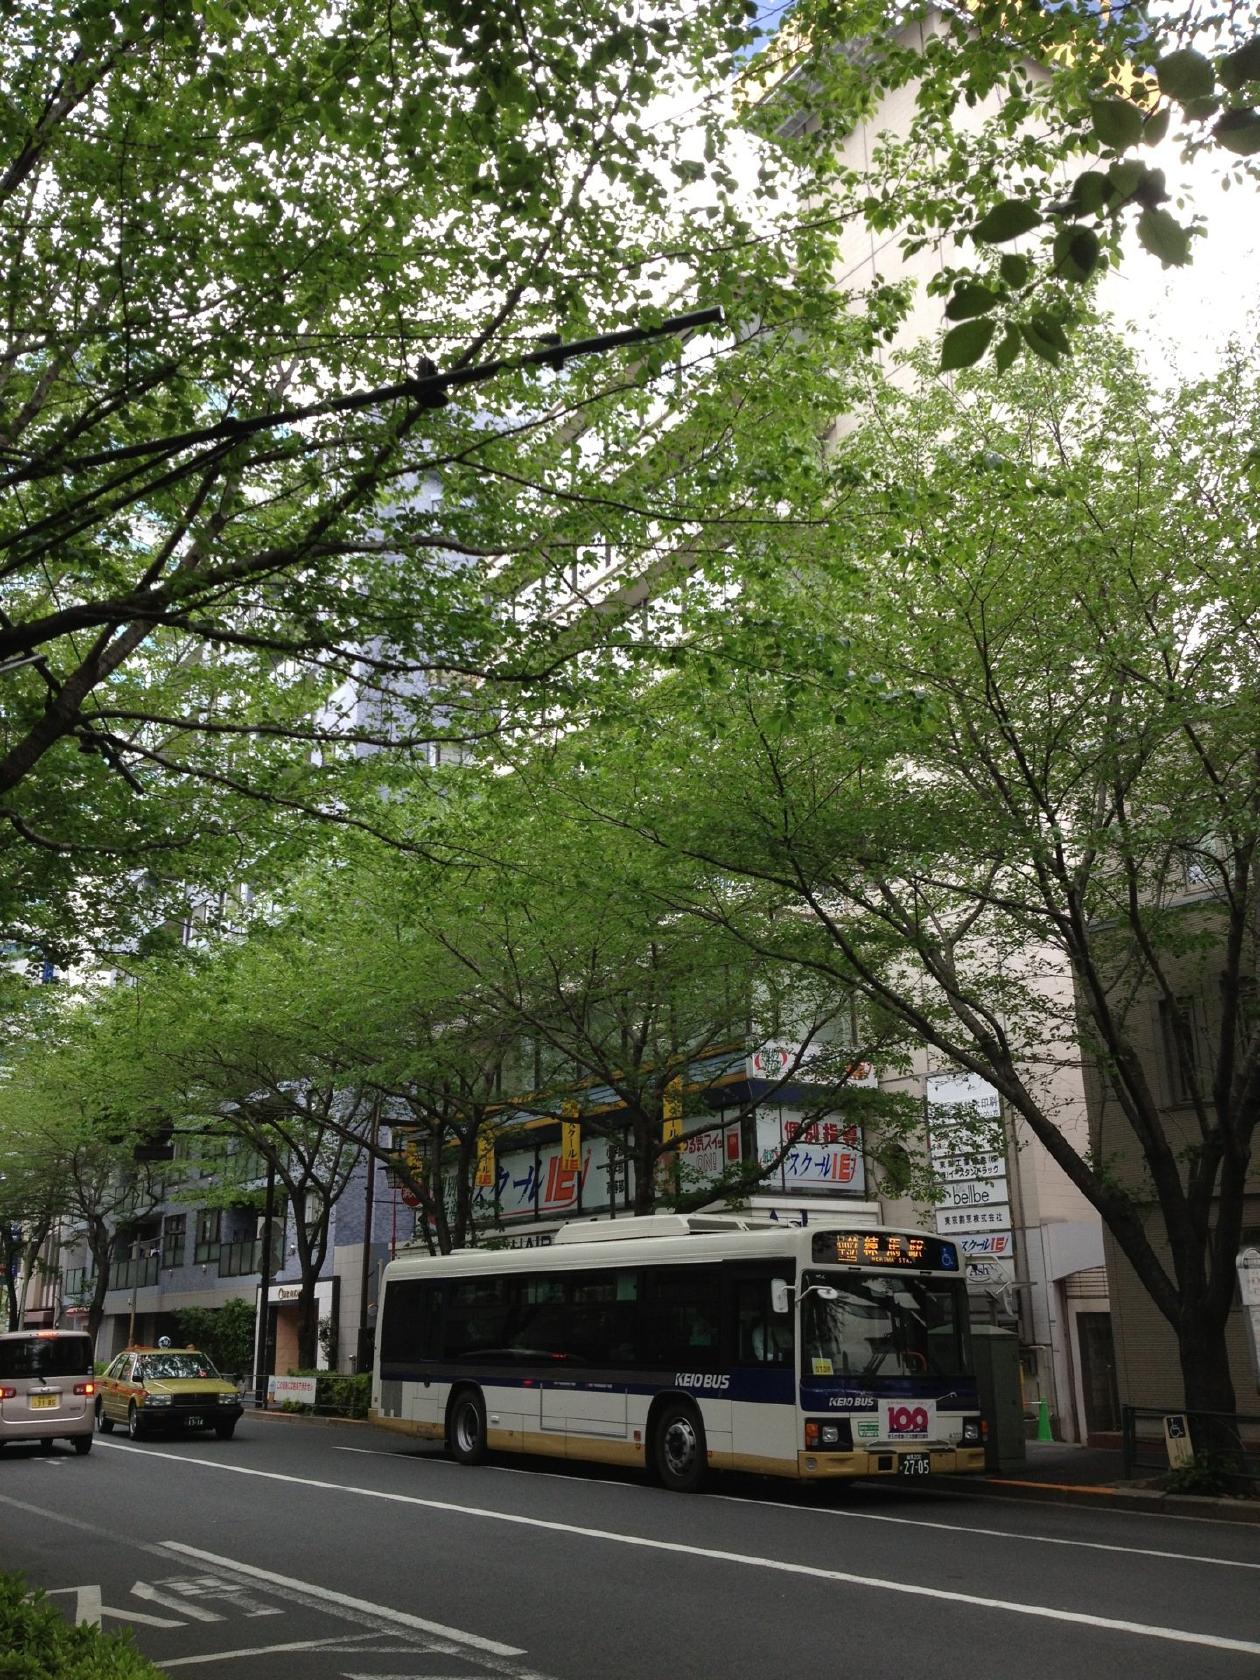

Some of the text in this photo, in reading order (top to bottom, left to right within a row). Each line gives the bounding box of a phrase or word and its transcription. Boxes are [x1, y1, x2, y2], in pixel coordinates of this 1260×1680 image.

[952, 1184, 990, 1206] bellbe
[674, 1372, 731, 1389] KEIO BUS
[829, 1397, 874, 1407] KEIO BUS
[887, 1406, 929, 1433] 100
[904, 1459, 930, 1475] 27-05
